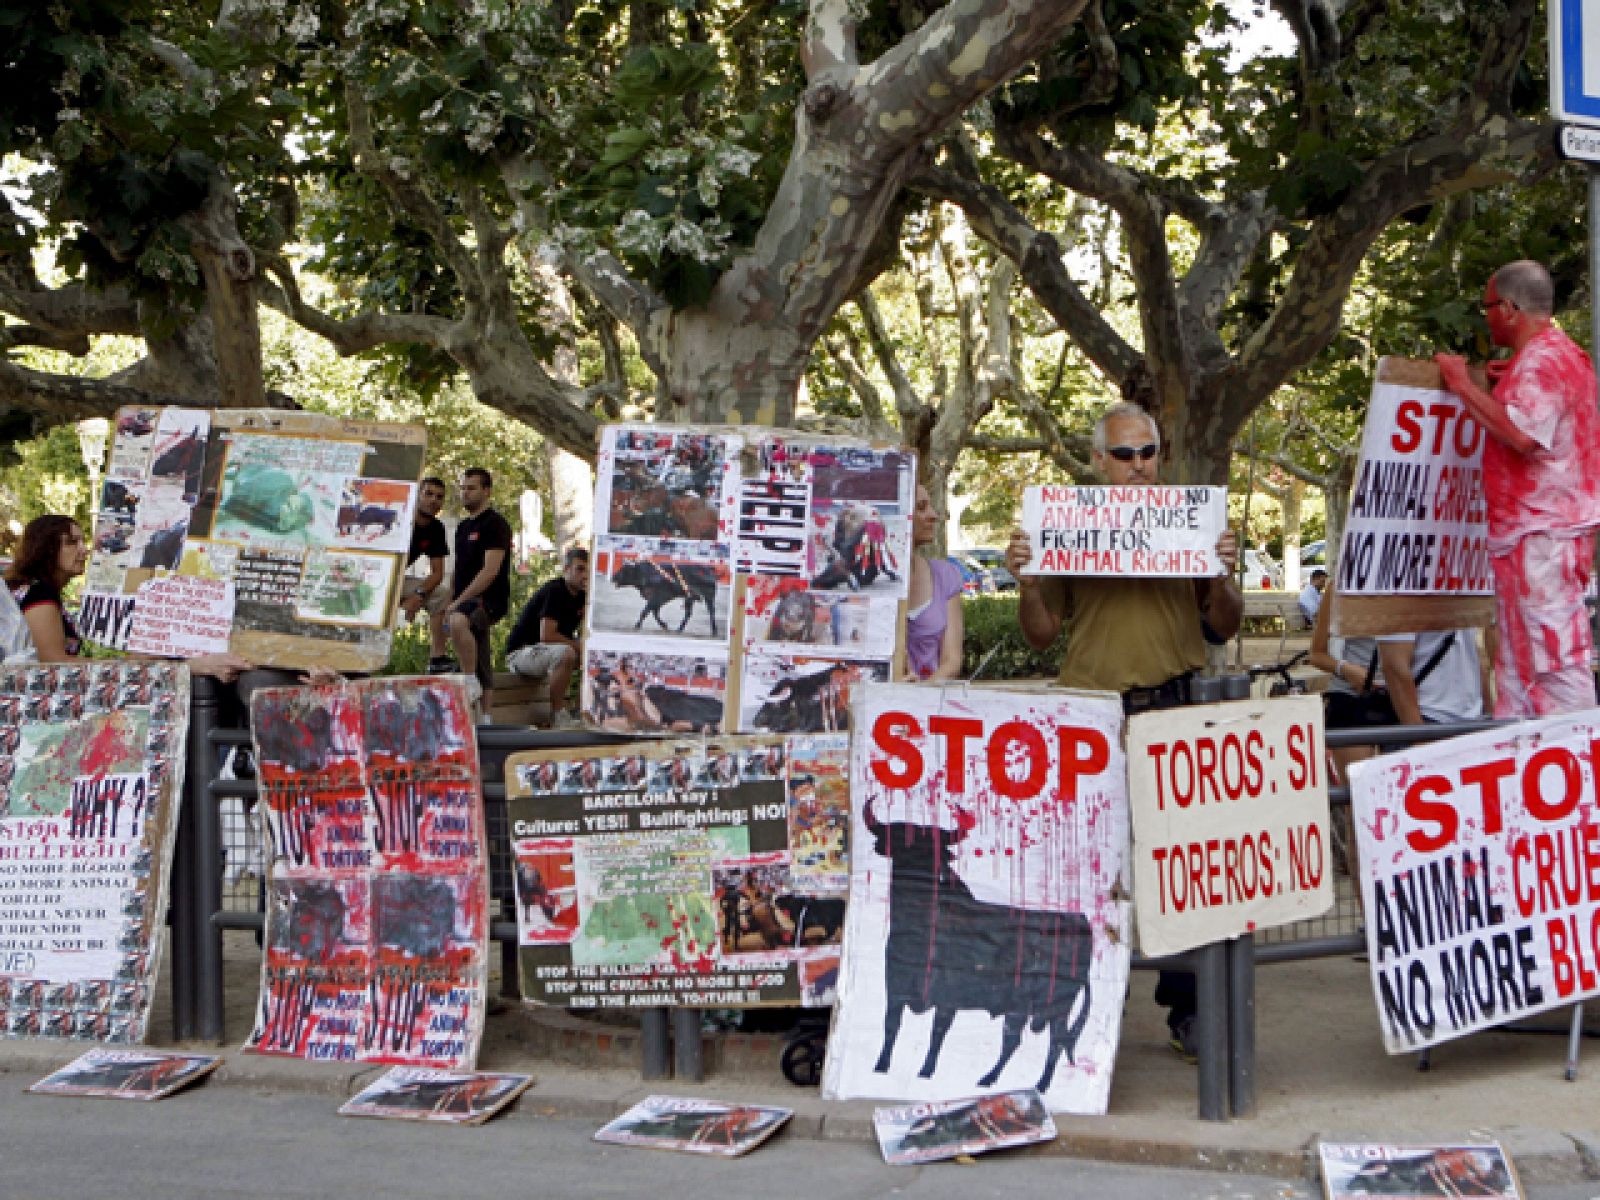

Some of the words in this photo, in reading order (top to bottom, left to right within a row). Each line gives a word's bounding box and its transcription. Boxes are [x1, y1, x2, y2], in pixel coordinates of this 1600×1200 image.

[1391, 400, 1480, 458] STO
[1352, 460, 1430, 520] ANIMAL
[1434, 465, 1485, 523] CRUEL
[737, 479, 808, 552] HELP
[1131, 507, 1199, 529] ABUSE
[1110, 530, 1151, 550] FOR
[1337, 532, 1376, 589] NO
[1375, 533, 1436, 589] MORE
[871, 711, 1110, 801] STOP
[1147, 729, 1276, 811] TOROS:
[1287, 724, 1317, 790] SI
[583, 793, 676, 811] BARCELONA
[1404, 739, 1600, 852] STO
[514, 819, 580, 836] Culture:
[20, 879, 66, 889] MORE
[70, 878, 130, 889] ANIMAL
[22, 864, 65, 874] MORE
[70, 863, 127, 874] BLOOD
[1152, 831, 1284, 916] TOREROS:
[1288, 823, 1323, 892] NO
[1, 894, 62, 905] ORTURE
[54, 909, 106, 920] NEVER
[1375, 847, 1504, 963] ANIMAL
[0, 952, 35, 972] VED
[52, 939, 84, 950] NOT
[87, 939, 108, 950] BE
[1378, 959, 1436, 1046] NO
[1439, 925, 1545, 1030] MORE
